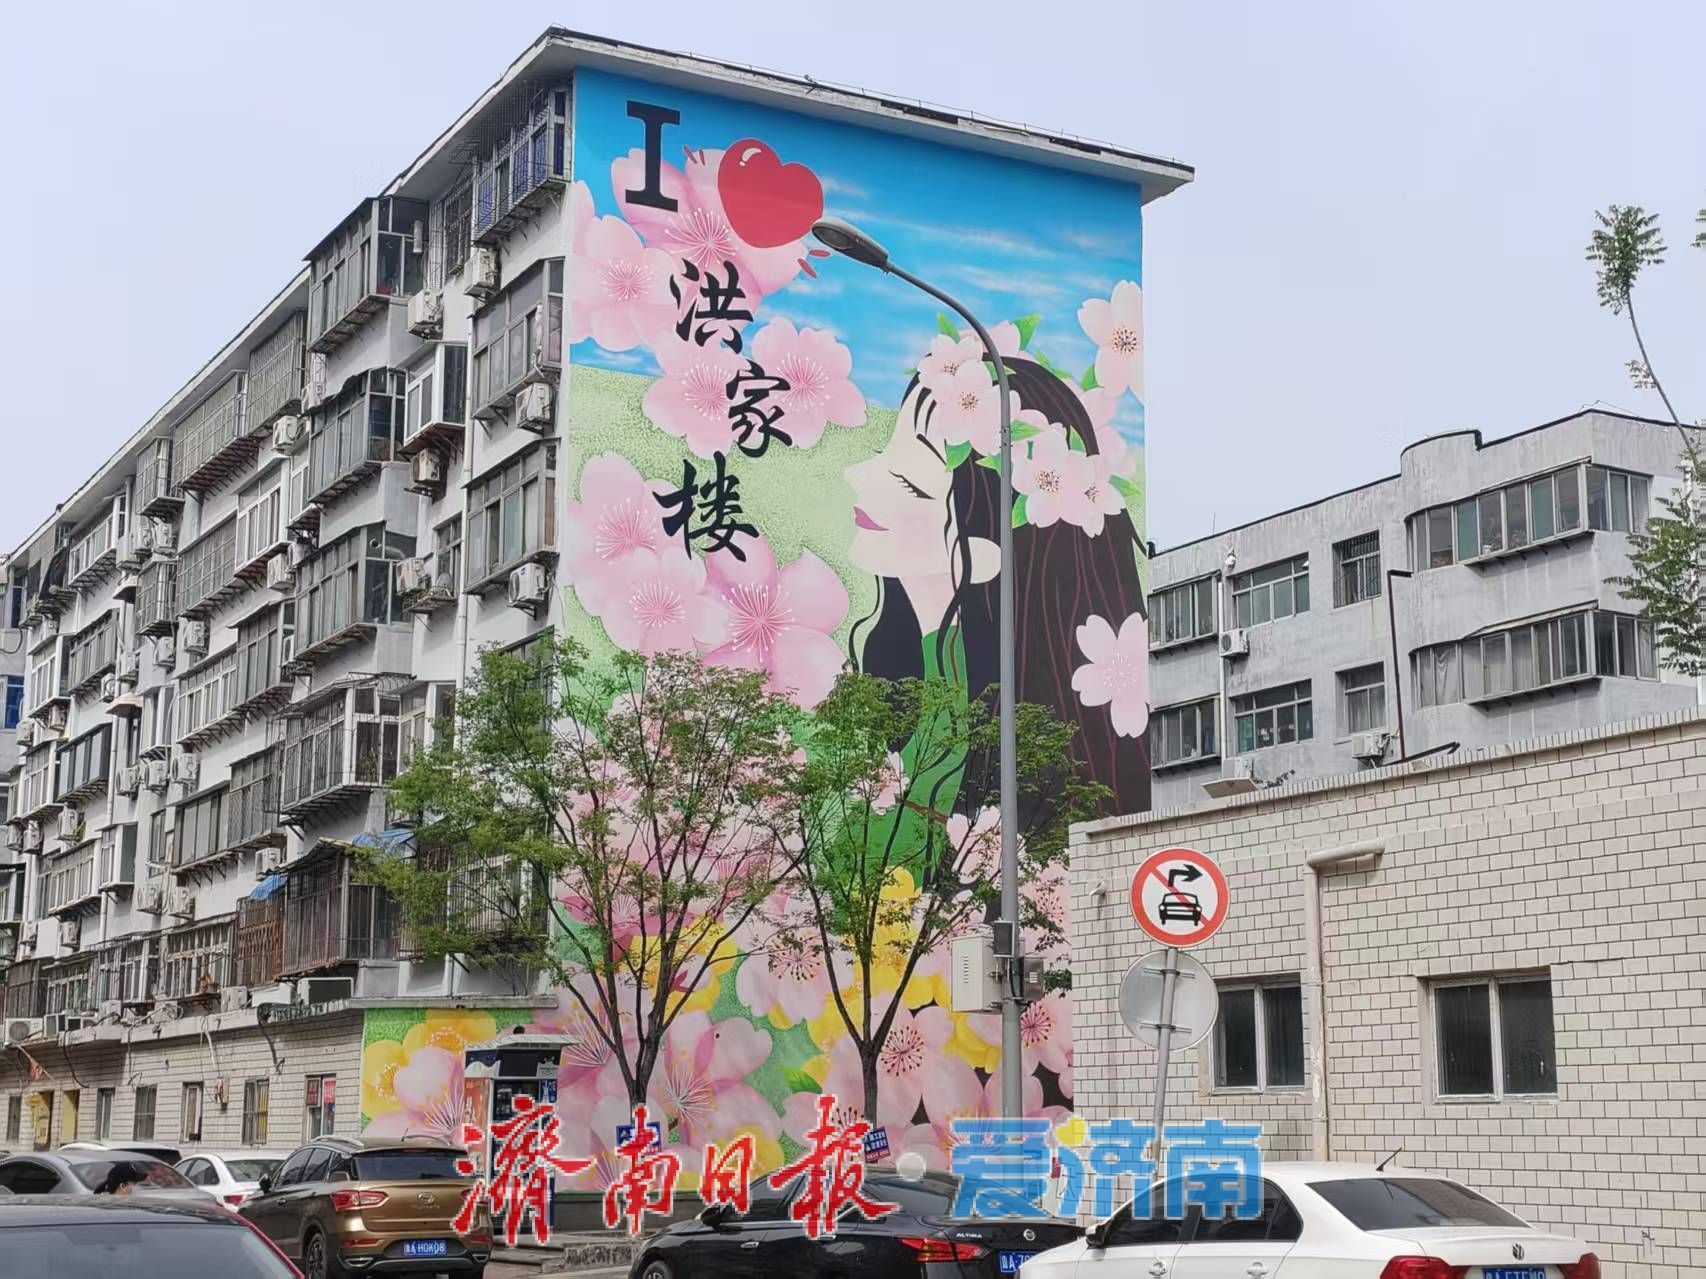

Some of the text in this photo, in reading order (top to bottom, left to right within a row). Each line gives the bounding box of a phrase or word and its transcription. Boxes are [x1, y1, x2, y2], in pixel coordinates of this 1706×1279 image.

[625, 101, 680, 212] I
[652, 258, 794, 562] 洪家楼
